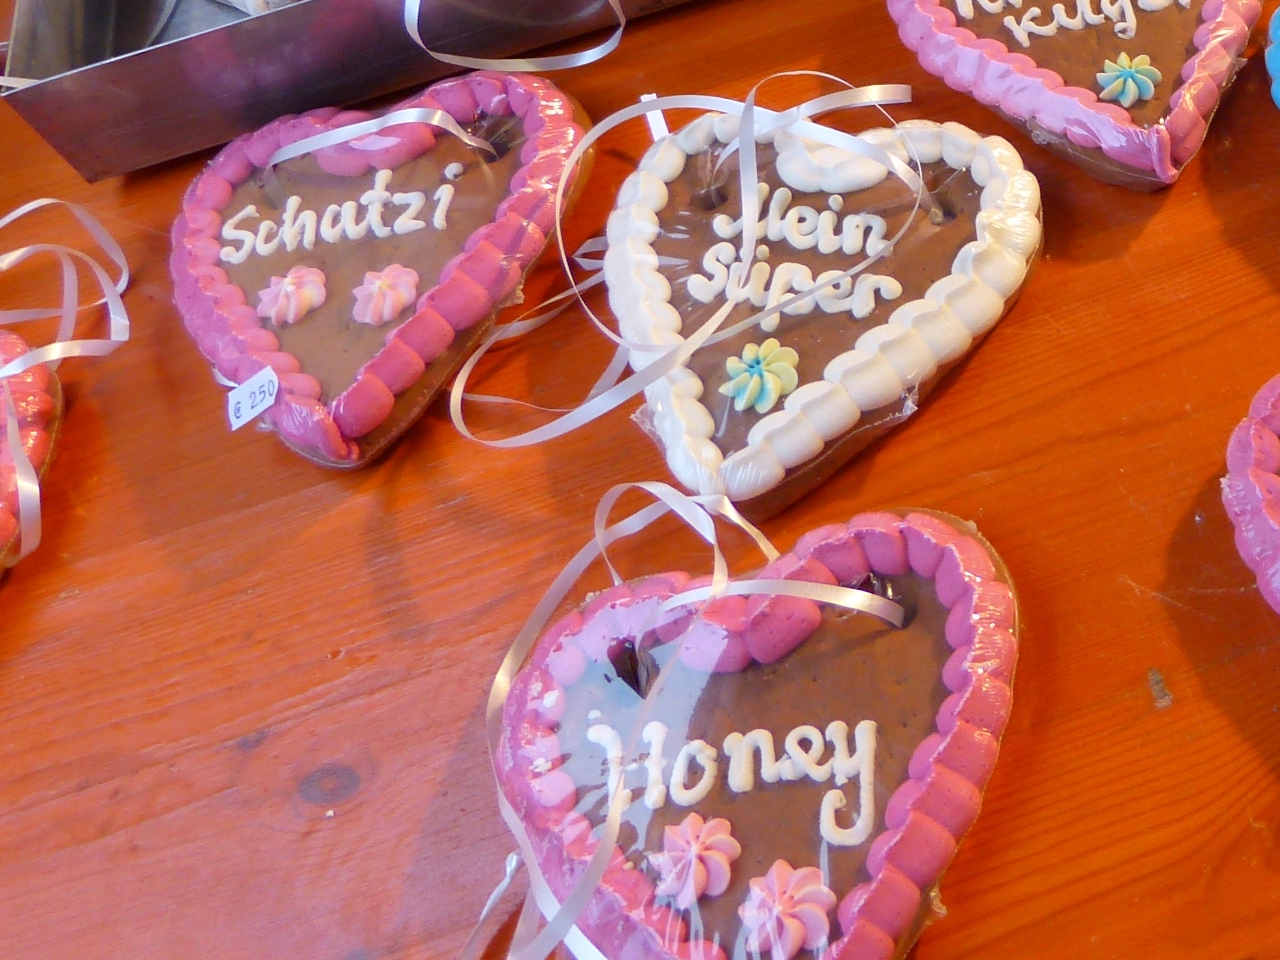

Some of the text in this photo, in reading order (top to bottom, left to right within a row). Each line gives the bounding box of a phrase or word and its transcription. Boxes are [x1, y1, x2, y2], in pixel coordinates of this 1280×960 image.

[218, 161, 466, 266] Schatzi
[711, 181, 897, 259] Mein
[232, 378, 276, 420] € 2.50
[586, 718, 878, 847] Honey
